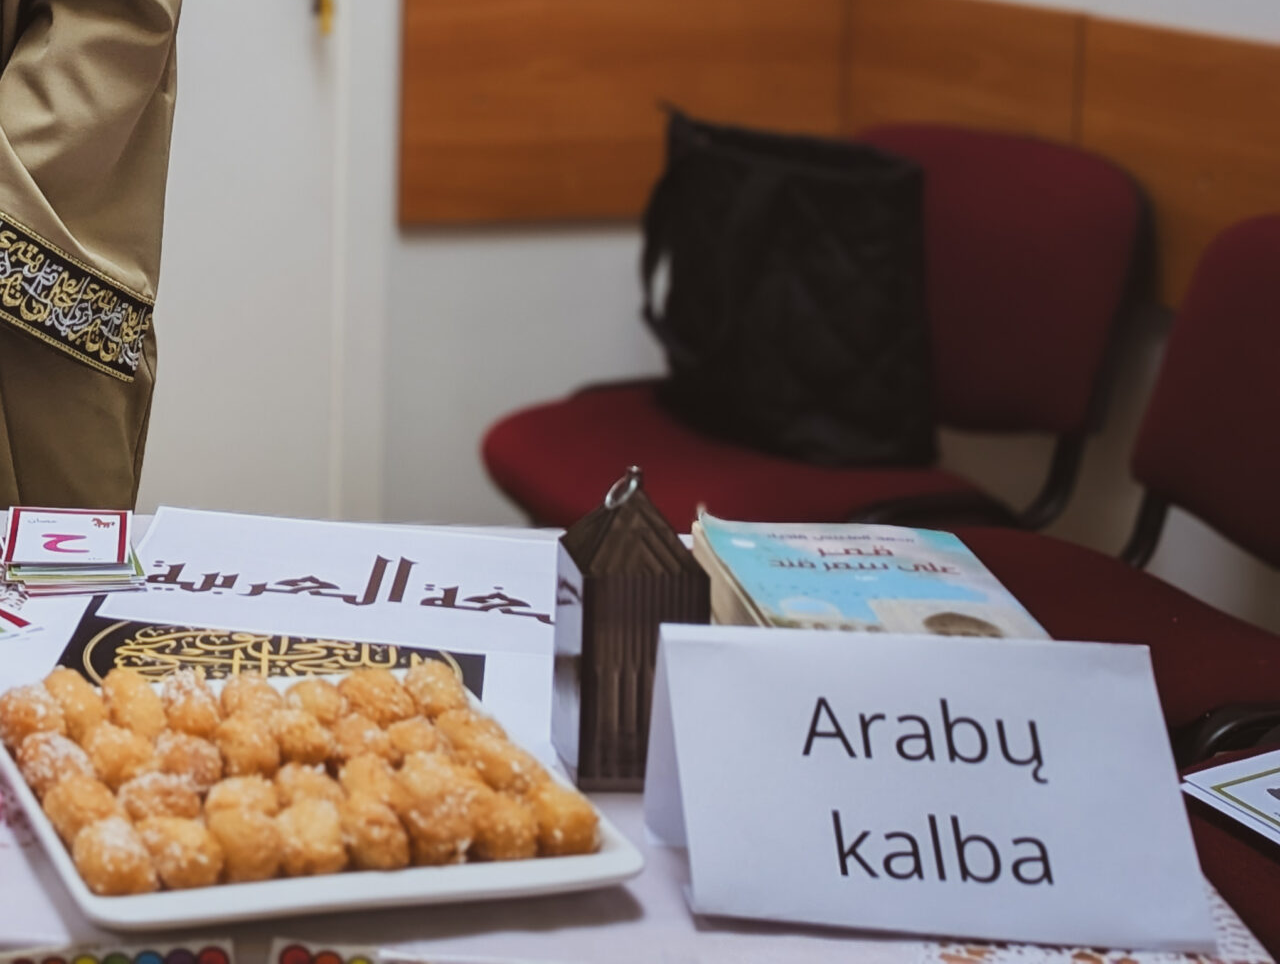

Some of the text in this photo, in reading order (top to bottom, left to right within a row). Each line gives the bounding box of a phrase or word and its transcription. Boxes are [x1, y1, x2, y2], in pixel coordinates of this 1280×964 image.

[41, 533, 90, 553] ح
[146, 554, 419, 607] العربية
[801, 696, 1050, 784] Arabų
[831, 809, 1054, 886] kalba
